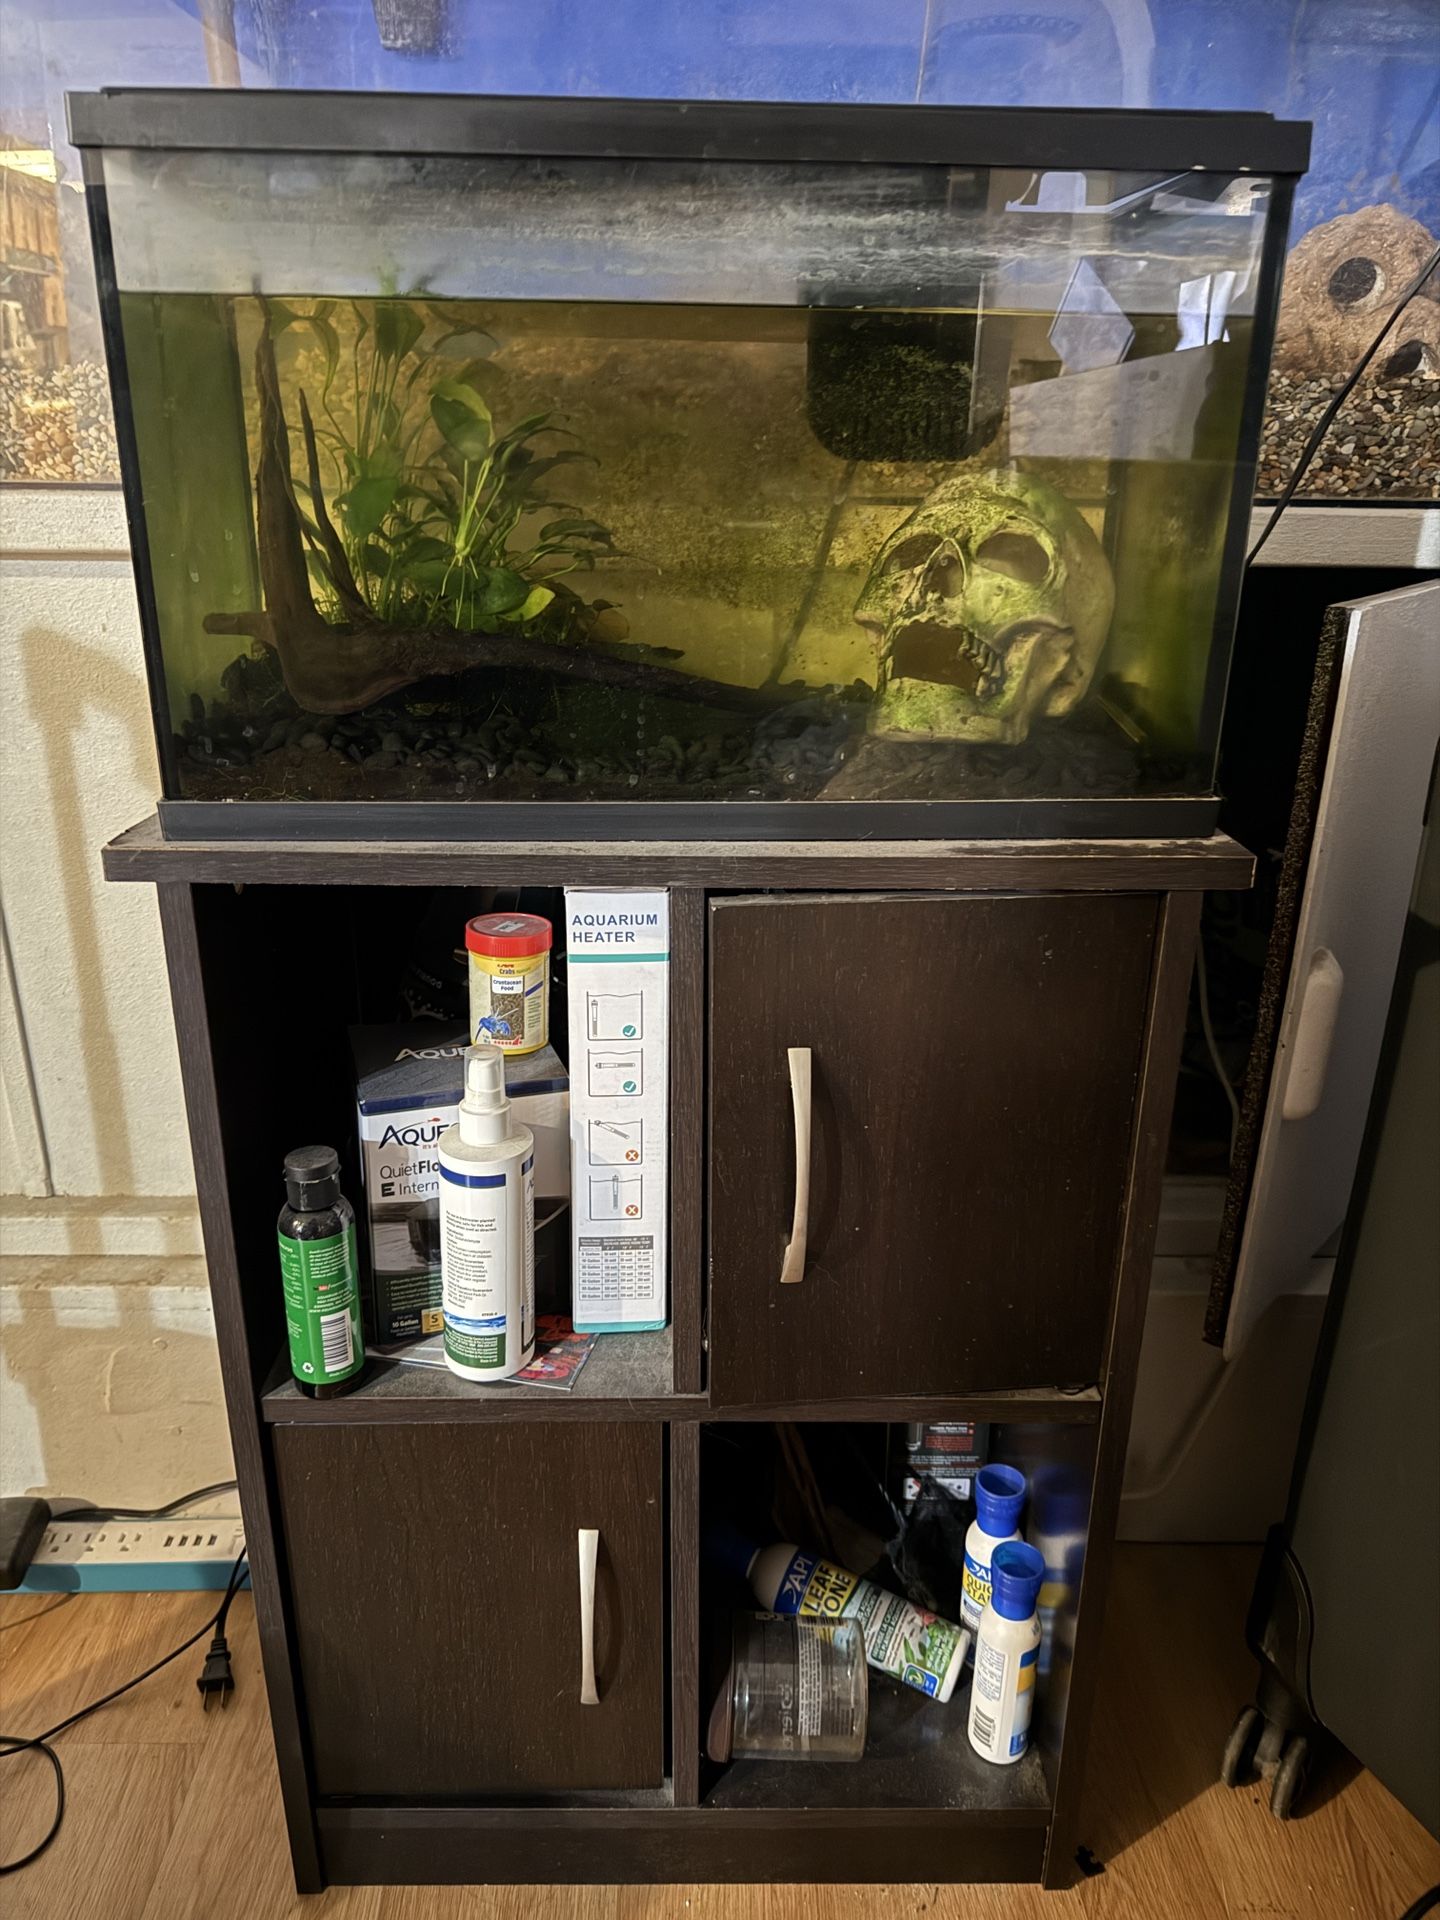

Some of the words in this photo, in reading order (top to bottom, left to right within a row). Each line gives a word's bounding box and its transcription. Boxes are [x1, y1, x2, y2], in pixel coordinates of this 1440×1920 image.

[572, 914, 658, 926] AQUARIUM
[573, 932, 635, 942] HEATER
[378, 1124, 458, 1150] AQUE
[381, 1182, 395, 1197] E
[431, 1314, 438, 1323] S
[789, 1556, 813, 1592] API
[804, 1564, 833, 1613] LEAF
[821, 1573, 851, 1617] ONE
